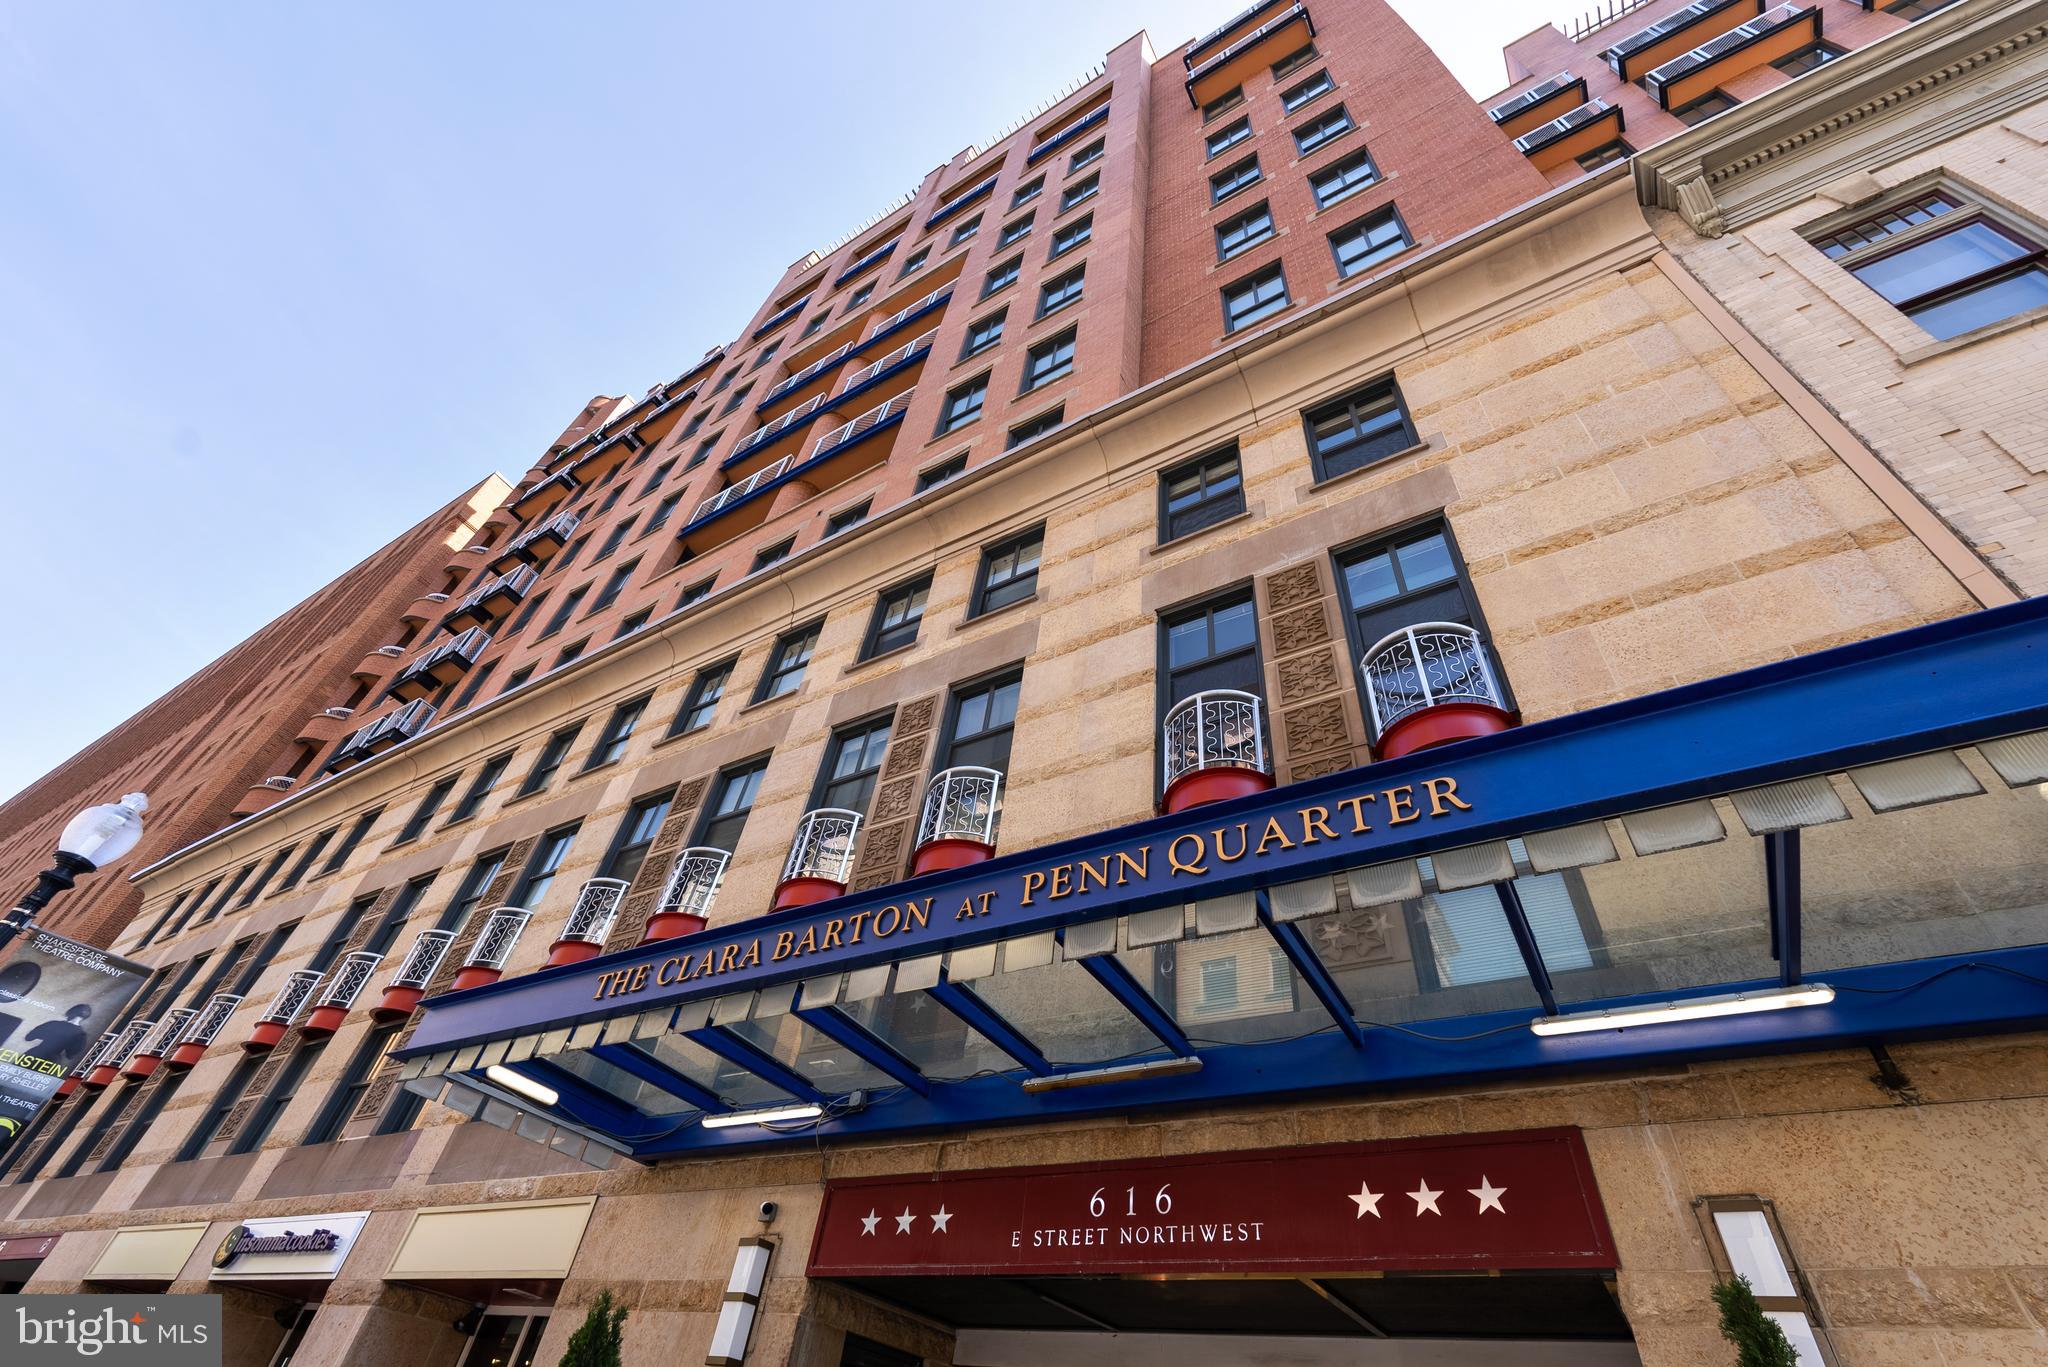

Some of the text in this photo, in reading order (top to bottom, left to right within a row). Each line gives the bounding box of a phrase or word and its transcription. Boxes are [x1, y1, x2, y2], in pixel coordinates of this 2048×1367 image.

[593, 776, 1472, 1000] THE CLARA BARTON AT PENN QUARTER
[31, 941, 125, 978] THEATRE COMPANY
[36, 933, 108, 963] SHAKESPEARE
[11, 1076, 48, 1091] SHELLEY
[3, 1095, 39, 1111] THEATRE
[1012, 1223, 1264, 1247] E STREET NORTHWEST
